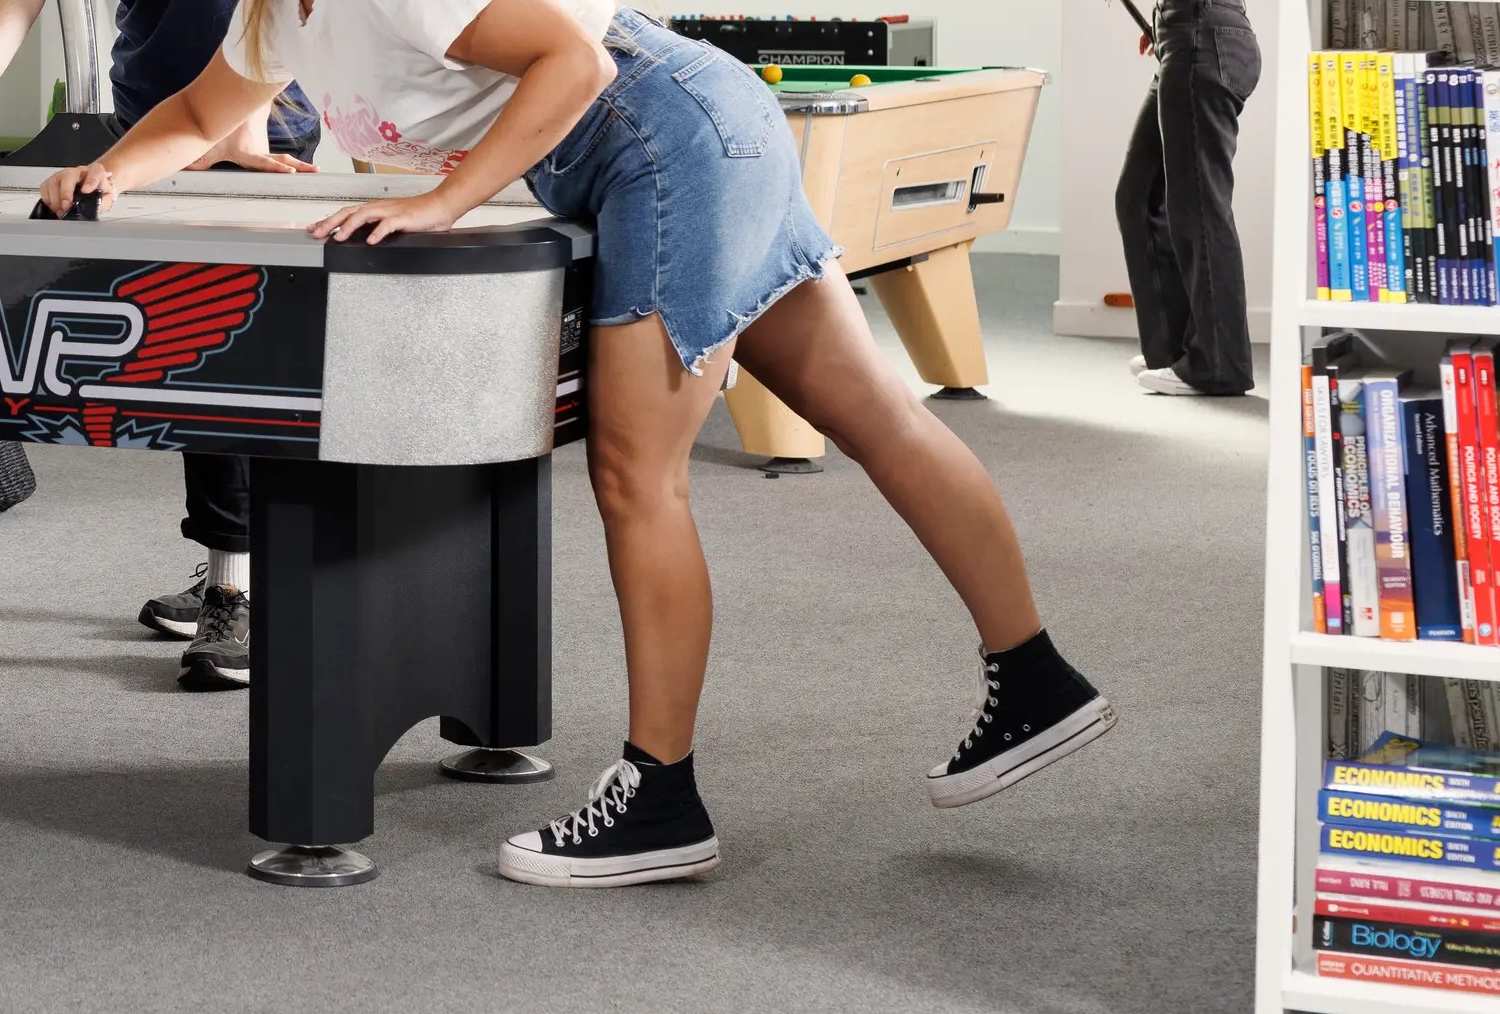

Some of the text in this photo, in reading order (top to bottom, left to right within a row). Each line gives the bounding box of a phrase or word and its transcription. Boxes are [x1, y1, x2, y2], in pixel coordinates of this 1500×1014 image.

[757, 53, 845, 65] CHAMPION
[1426, 73, 1436, 85] 9
[1448, 74, 1459, 86] 8
[1319, 414, 1329, 434] FOR
[1380, 389, 1402, 489] ORGANIZATIONAL
[1414, 413, 1424, 455] Second Edition
[1306, 450, 1318, 477] FOCUS
[1320, 436, 1331, 478] LAWYERS
[1355, 435, 1369, 501] PRINCIPLES
[1344, 435, 1359, 518] ECONOMICS
[1424, 413, 1445, 536] Advanced Mathematics
[1309, 494, 1320, 517] IELTS
[1464, 445, 1482, 540] POLITICS AND SOCIETY
[1485, 447, 1500, 541] POLITICS AND SOCIETY
[1359, 499, 1370, 517] OF
[1387, 491, 1406, 559] BEHAVIOUR
[1333, 671, 1346, 716] Britain
[1334, 765, 1445, 790] ECONOMICS
[1327, 797, 1442, 827] ECONOMICS
[1444, 820, 1474, 832] EDITION
[1329, 829, 1445, 860] ECONOMICS
[1446, 852, 1476, 864] EDITION
[1351, 924, 1442, 957] Biology
[1350, 961, 1443, 984] QUANTITATIVE
